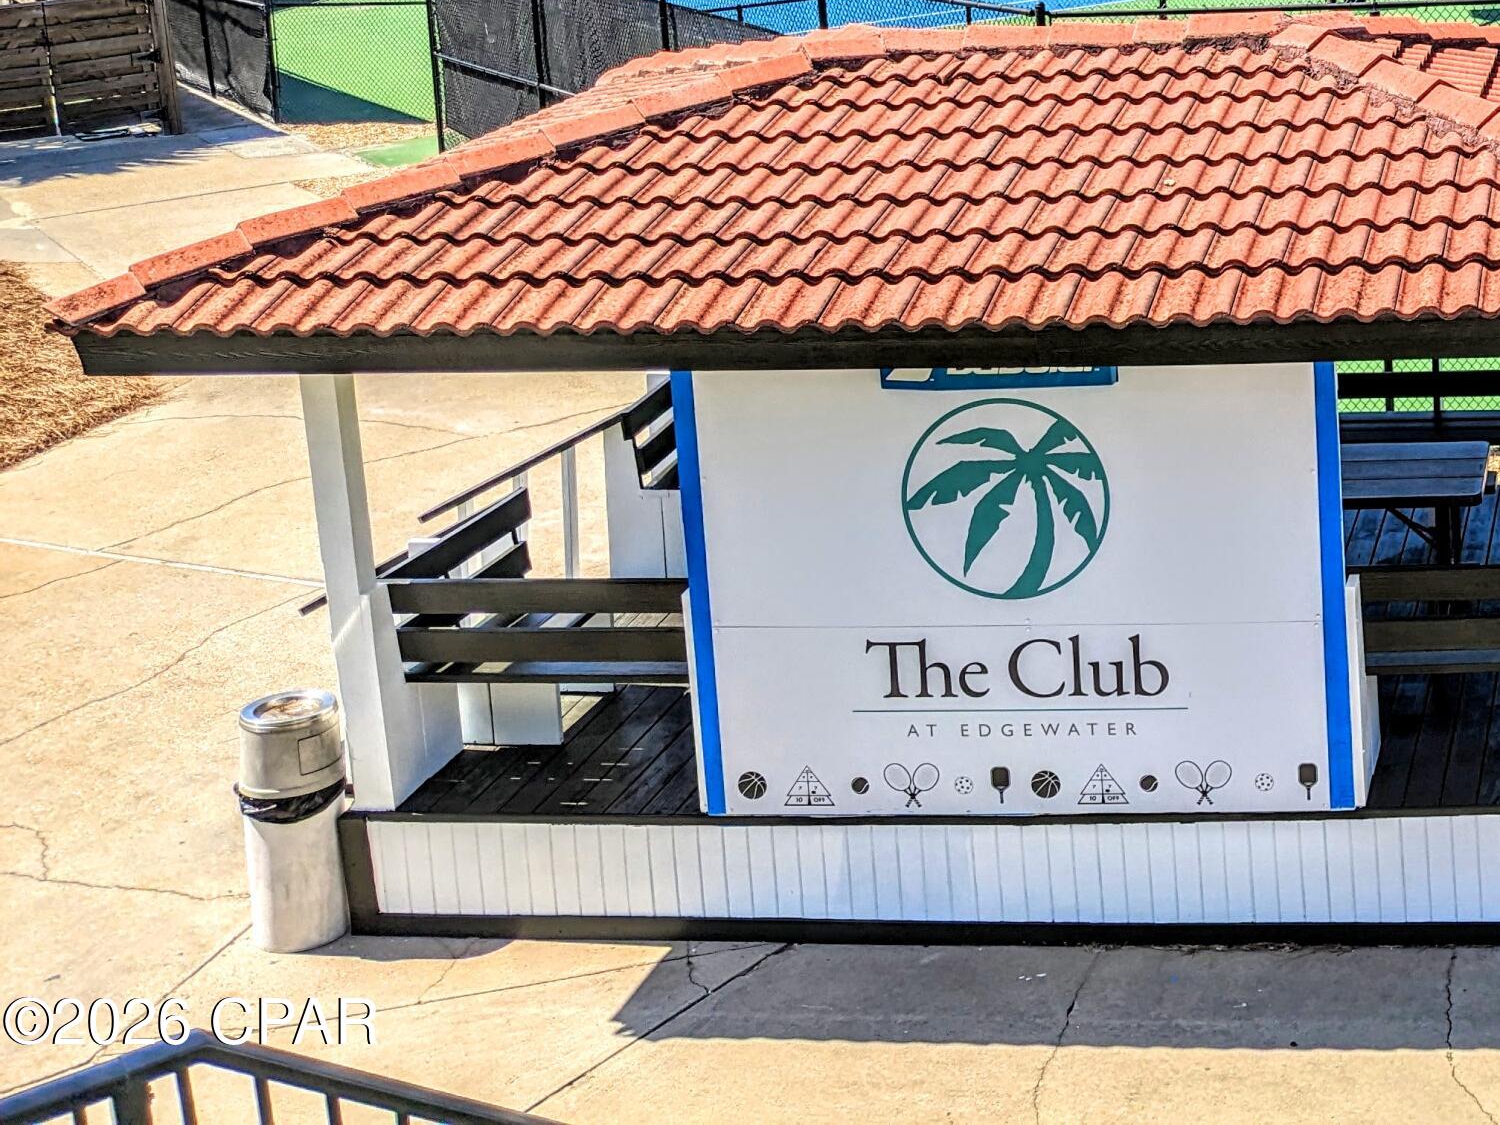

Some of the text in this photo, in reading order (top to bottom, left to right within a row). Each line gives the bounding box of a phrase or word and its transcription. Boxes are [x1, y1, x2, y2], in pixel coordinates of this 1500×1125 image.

[866, 633, 1170, 699] The Club
[907, 722, 1138, 738] AT EDGEWATER
